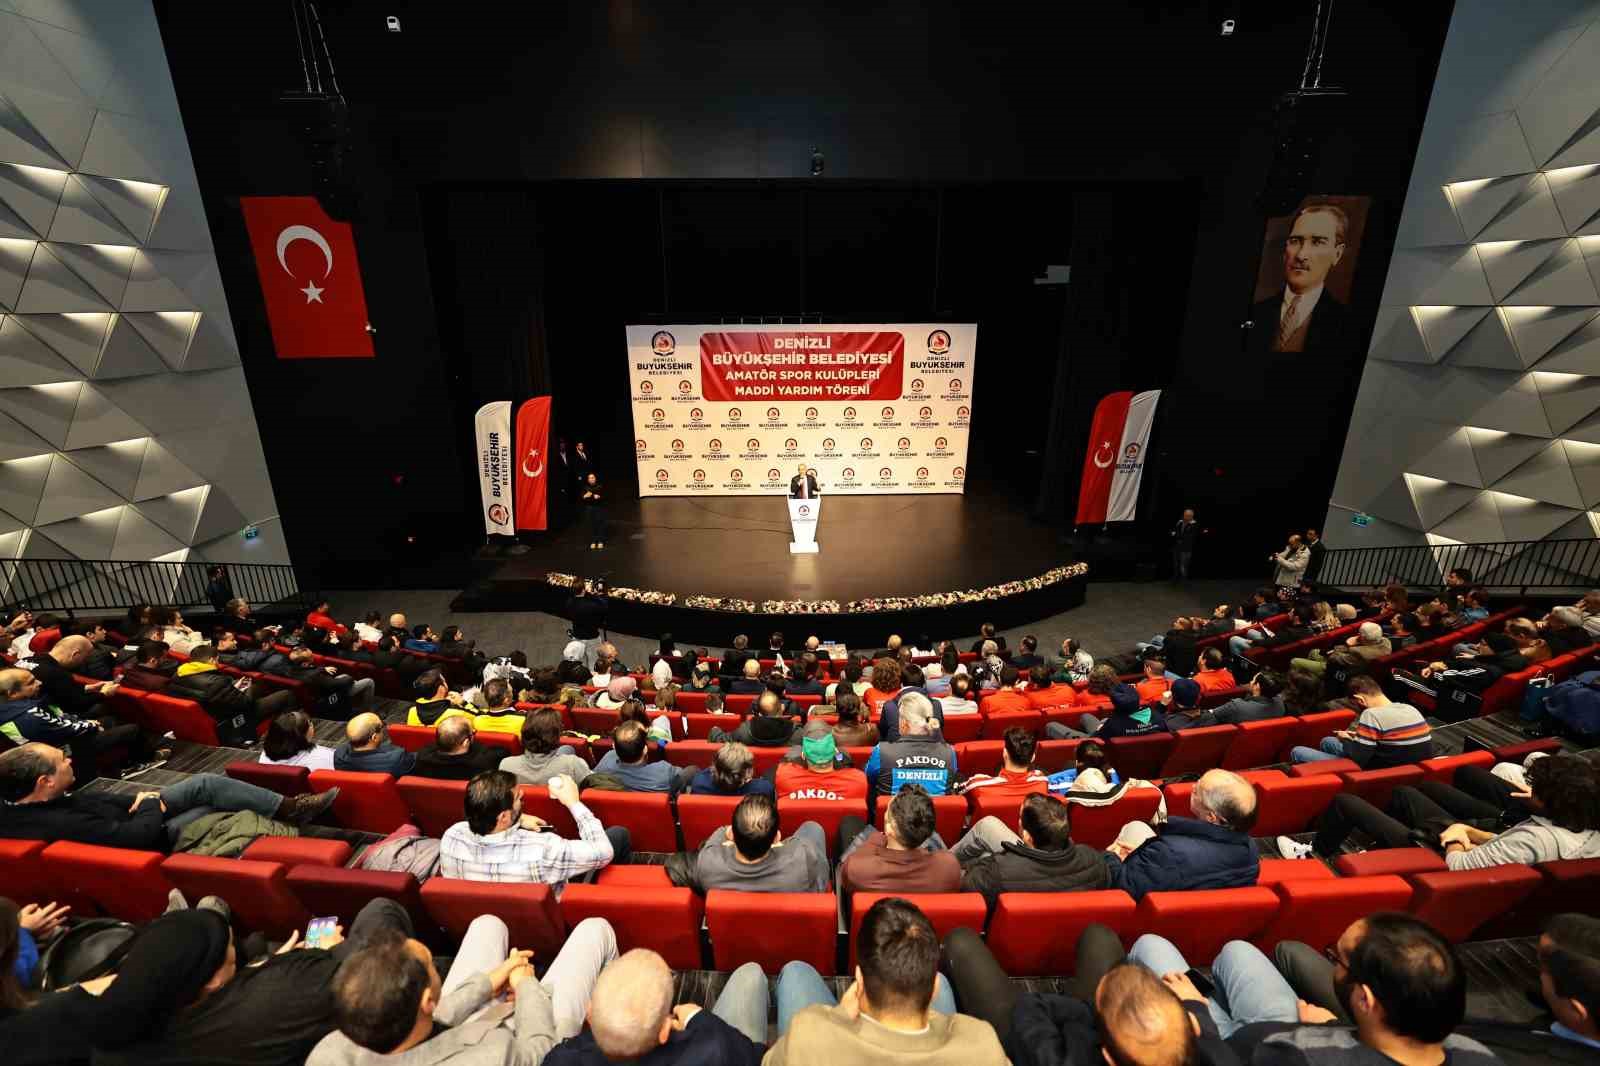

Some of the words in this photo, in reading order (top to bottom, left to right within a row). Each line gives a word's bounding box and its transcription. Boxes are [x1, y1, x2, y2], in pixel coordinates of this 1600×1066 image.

[774, 335, 831, 349] DENİZLİ
[712, 351, 806, 367] BÜYÜKŞEHİR
[809, 351, 892, 365] BELEDİYESİ
[726, 369, 777, 380] AMATÖR
[780, 370, 812, 380] SPOR
[815, 368, 881, 380] KULÜPLERİ
[735, 383, 774, 395] MADDİ
[777, 385, 823, 395] YARDIM
[825, 383, 870, 395] TÖRENİ
[895, 755, 946, 768] PAKDOS
